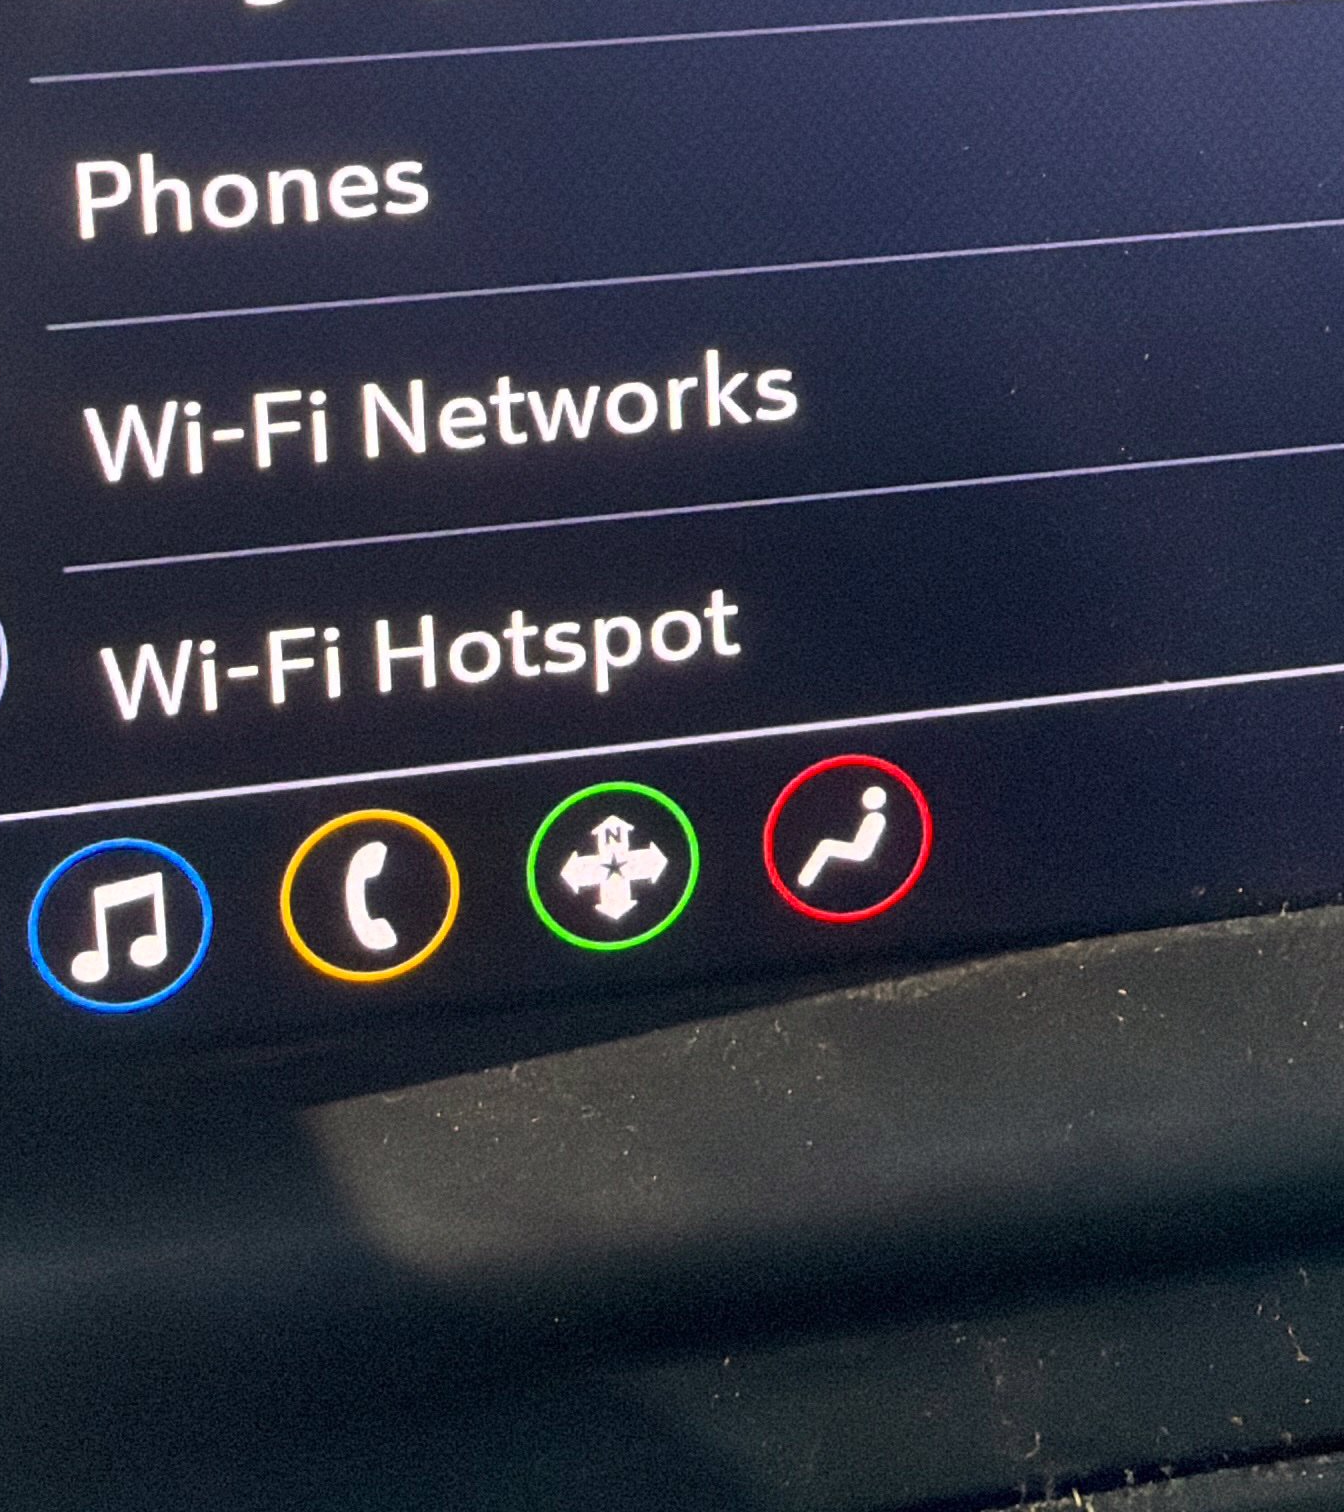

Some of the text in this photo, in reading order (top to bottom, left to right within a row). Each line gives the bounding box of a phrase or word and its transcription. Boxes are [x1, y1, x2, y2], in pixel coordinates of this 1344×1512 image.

[73, 150, 431, 243] Phones
[81, 347, 800, 485] Wi-Fi Networks
[97, 586, 744, 723] Wi-Fi Hotspot
